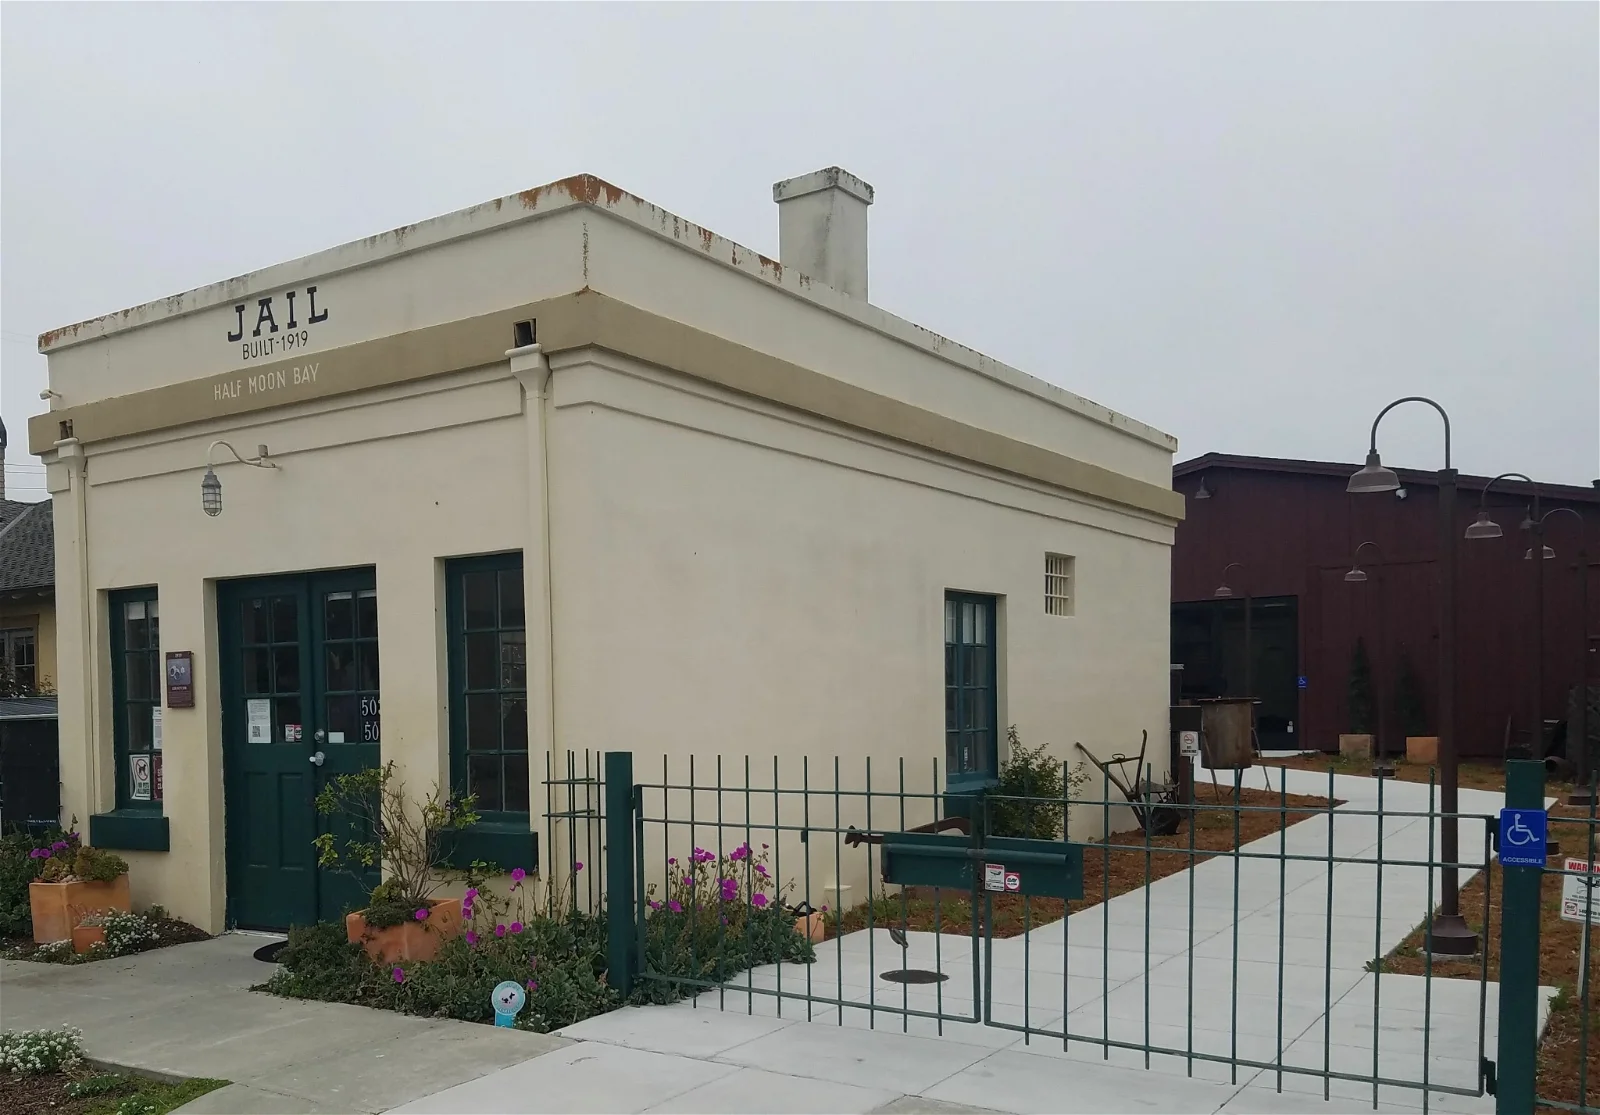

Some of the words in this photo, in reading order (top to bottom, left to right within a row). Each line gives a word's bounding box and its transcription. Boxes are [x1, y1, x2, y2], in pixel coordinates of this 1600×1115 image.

[227, 286, 328, 342] JAIL
[242, 330, 308, 360] BUILT-1919
[214, 380, 242, 400] HALF
[248, 370, 286, 394] MOON
[293, 363, 320, 384] BAY
[1502, 856, 1543, 865] ACCESSIBLE
[1568, 861, 1600, 874] WARIN
